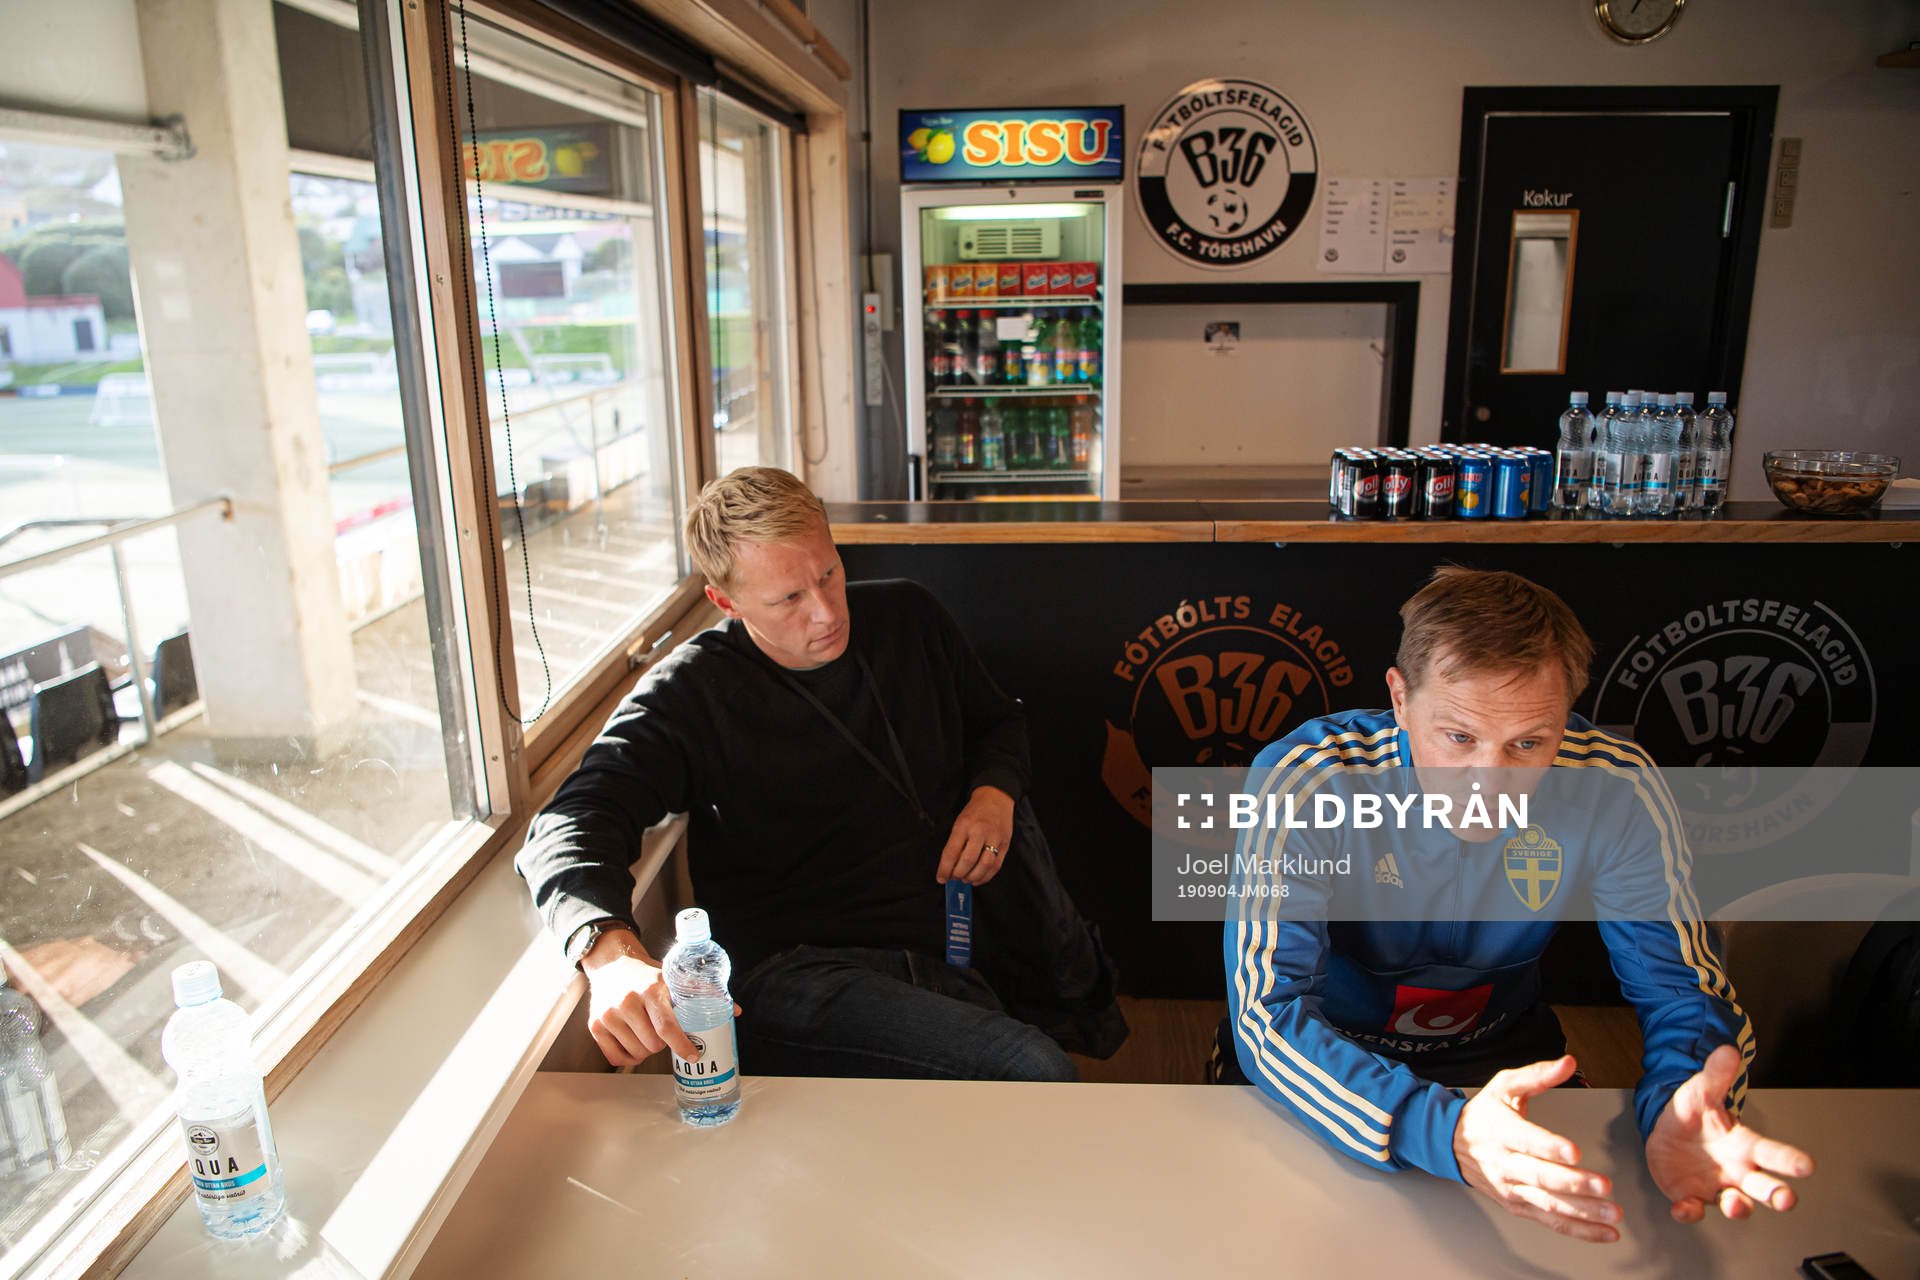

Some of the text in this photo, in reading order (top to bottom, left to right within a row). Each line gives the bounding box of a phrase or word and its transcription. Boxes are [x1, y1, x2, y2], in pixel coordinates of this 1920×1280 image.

[963, 119, 1112, 166] SISU
[1179, 126, 1277, 189] B36
[1165, 221, 1193, 250] F.C.
[1155, 651, 1313, 742] B36
[1660, 655, 1817, 745] B36
[1512, 849, 1553, 858] SVERIGE
[675, 1059, 718, 1076] AQUA
